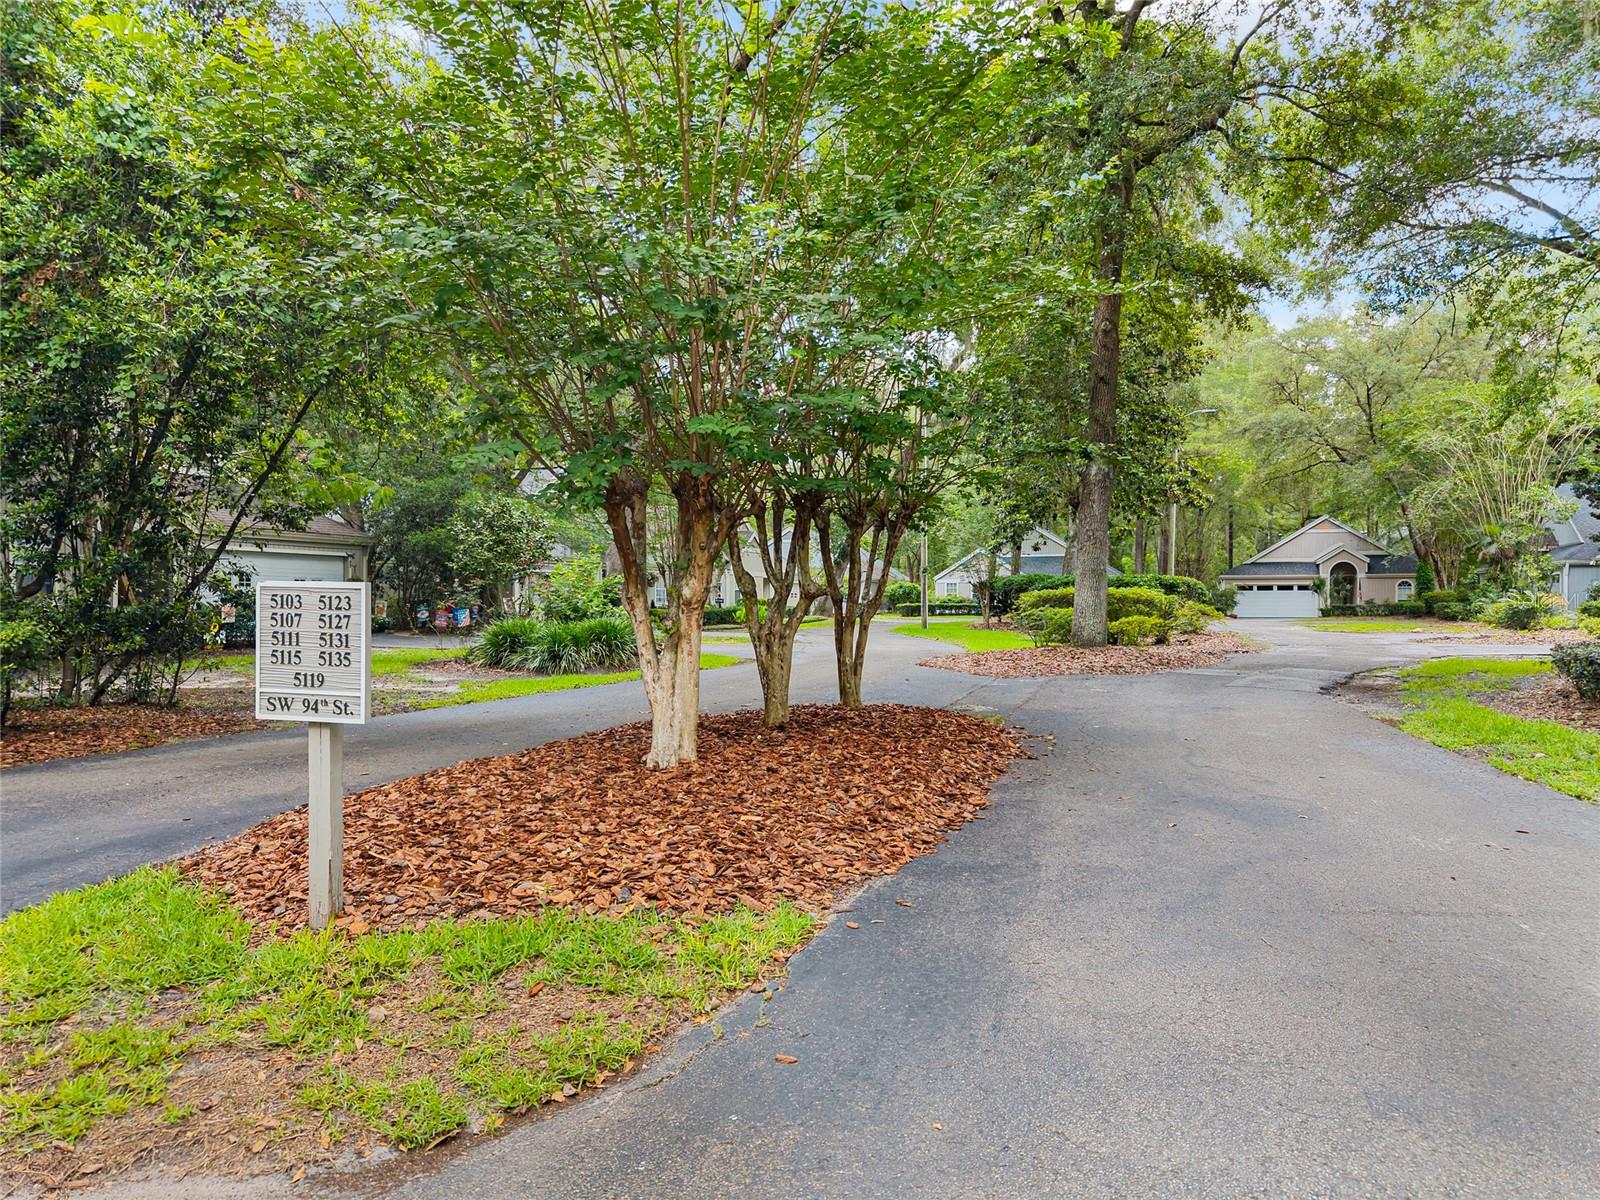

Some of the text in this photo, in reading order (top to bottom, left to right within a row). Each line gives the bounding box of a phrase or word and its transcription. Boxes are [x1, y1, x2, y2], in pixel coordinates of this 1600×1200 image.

[270, 594, 351, 610] 5103 5123
[270, 613, 351, 629] 5107 5127
[271, 631, 350, 648] 5111 5131
[270, 650, 351, 667] 5115 5135
[293, 673, 324, 687] 5119
[266, 697, 354, 715] SW 94th St.
